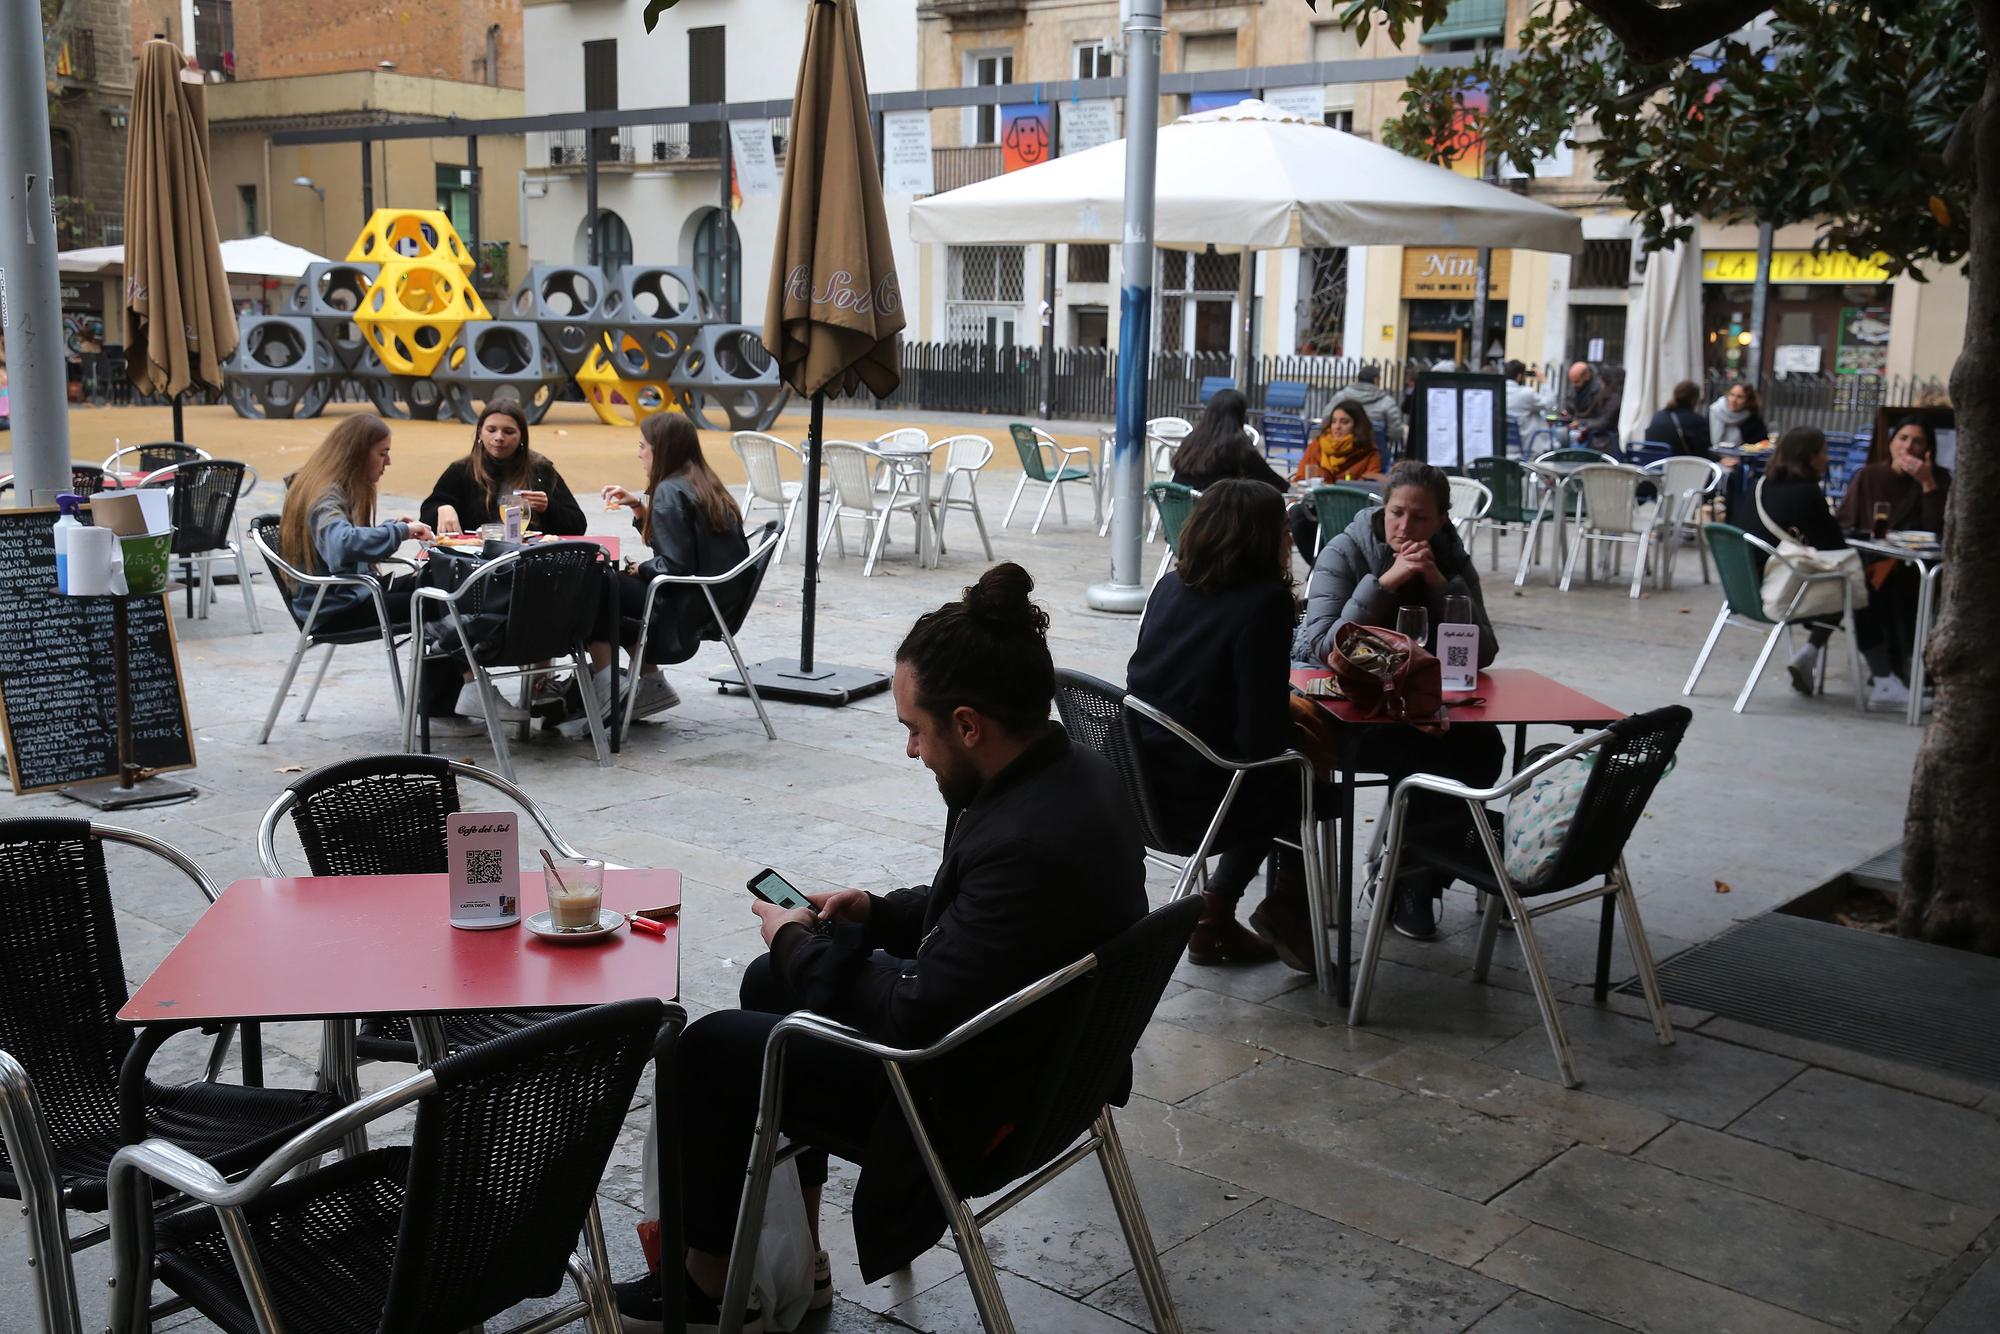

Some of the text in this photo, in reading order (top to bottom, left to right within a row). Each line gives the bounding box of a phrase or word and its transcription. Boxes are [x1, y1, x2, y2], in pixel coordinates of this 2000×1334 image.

[1420, 253, 1477, 277] Nin
[1715, 256, 1747, 277] LA
[136, 729, 172, 740] CASERO
[478, 825, 493, 833] del
[493, 824, 510, 832] Sol
